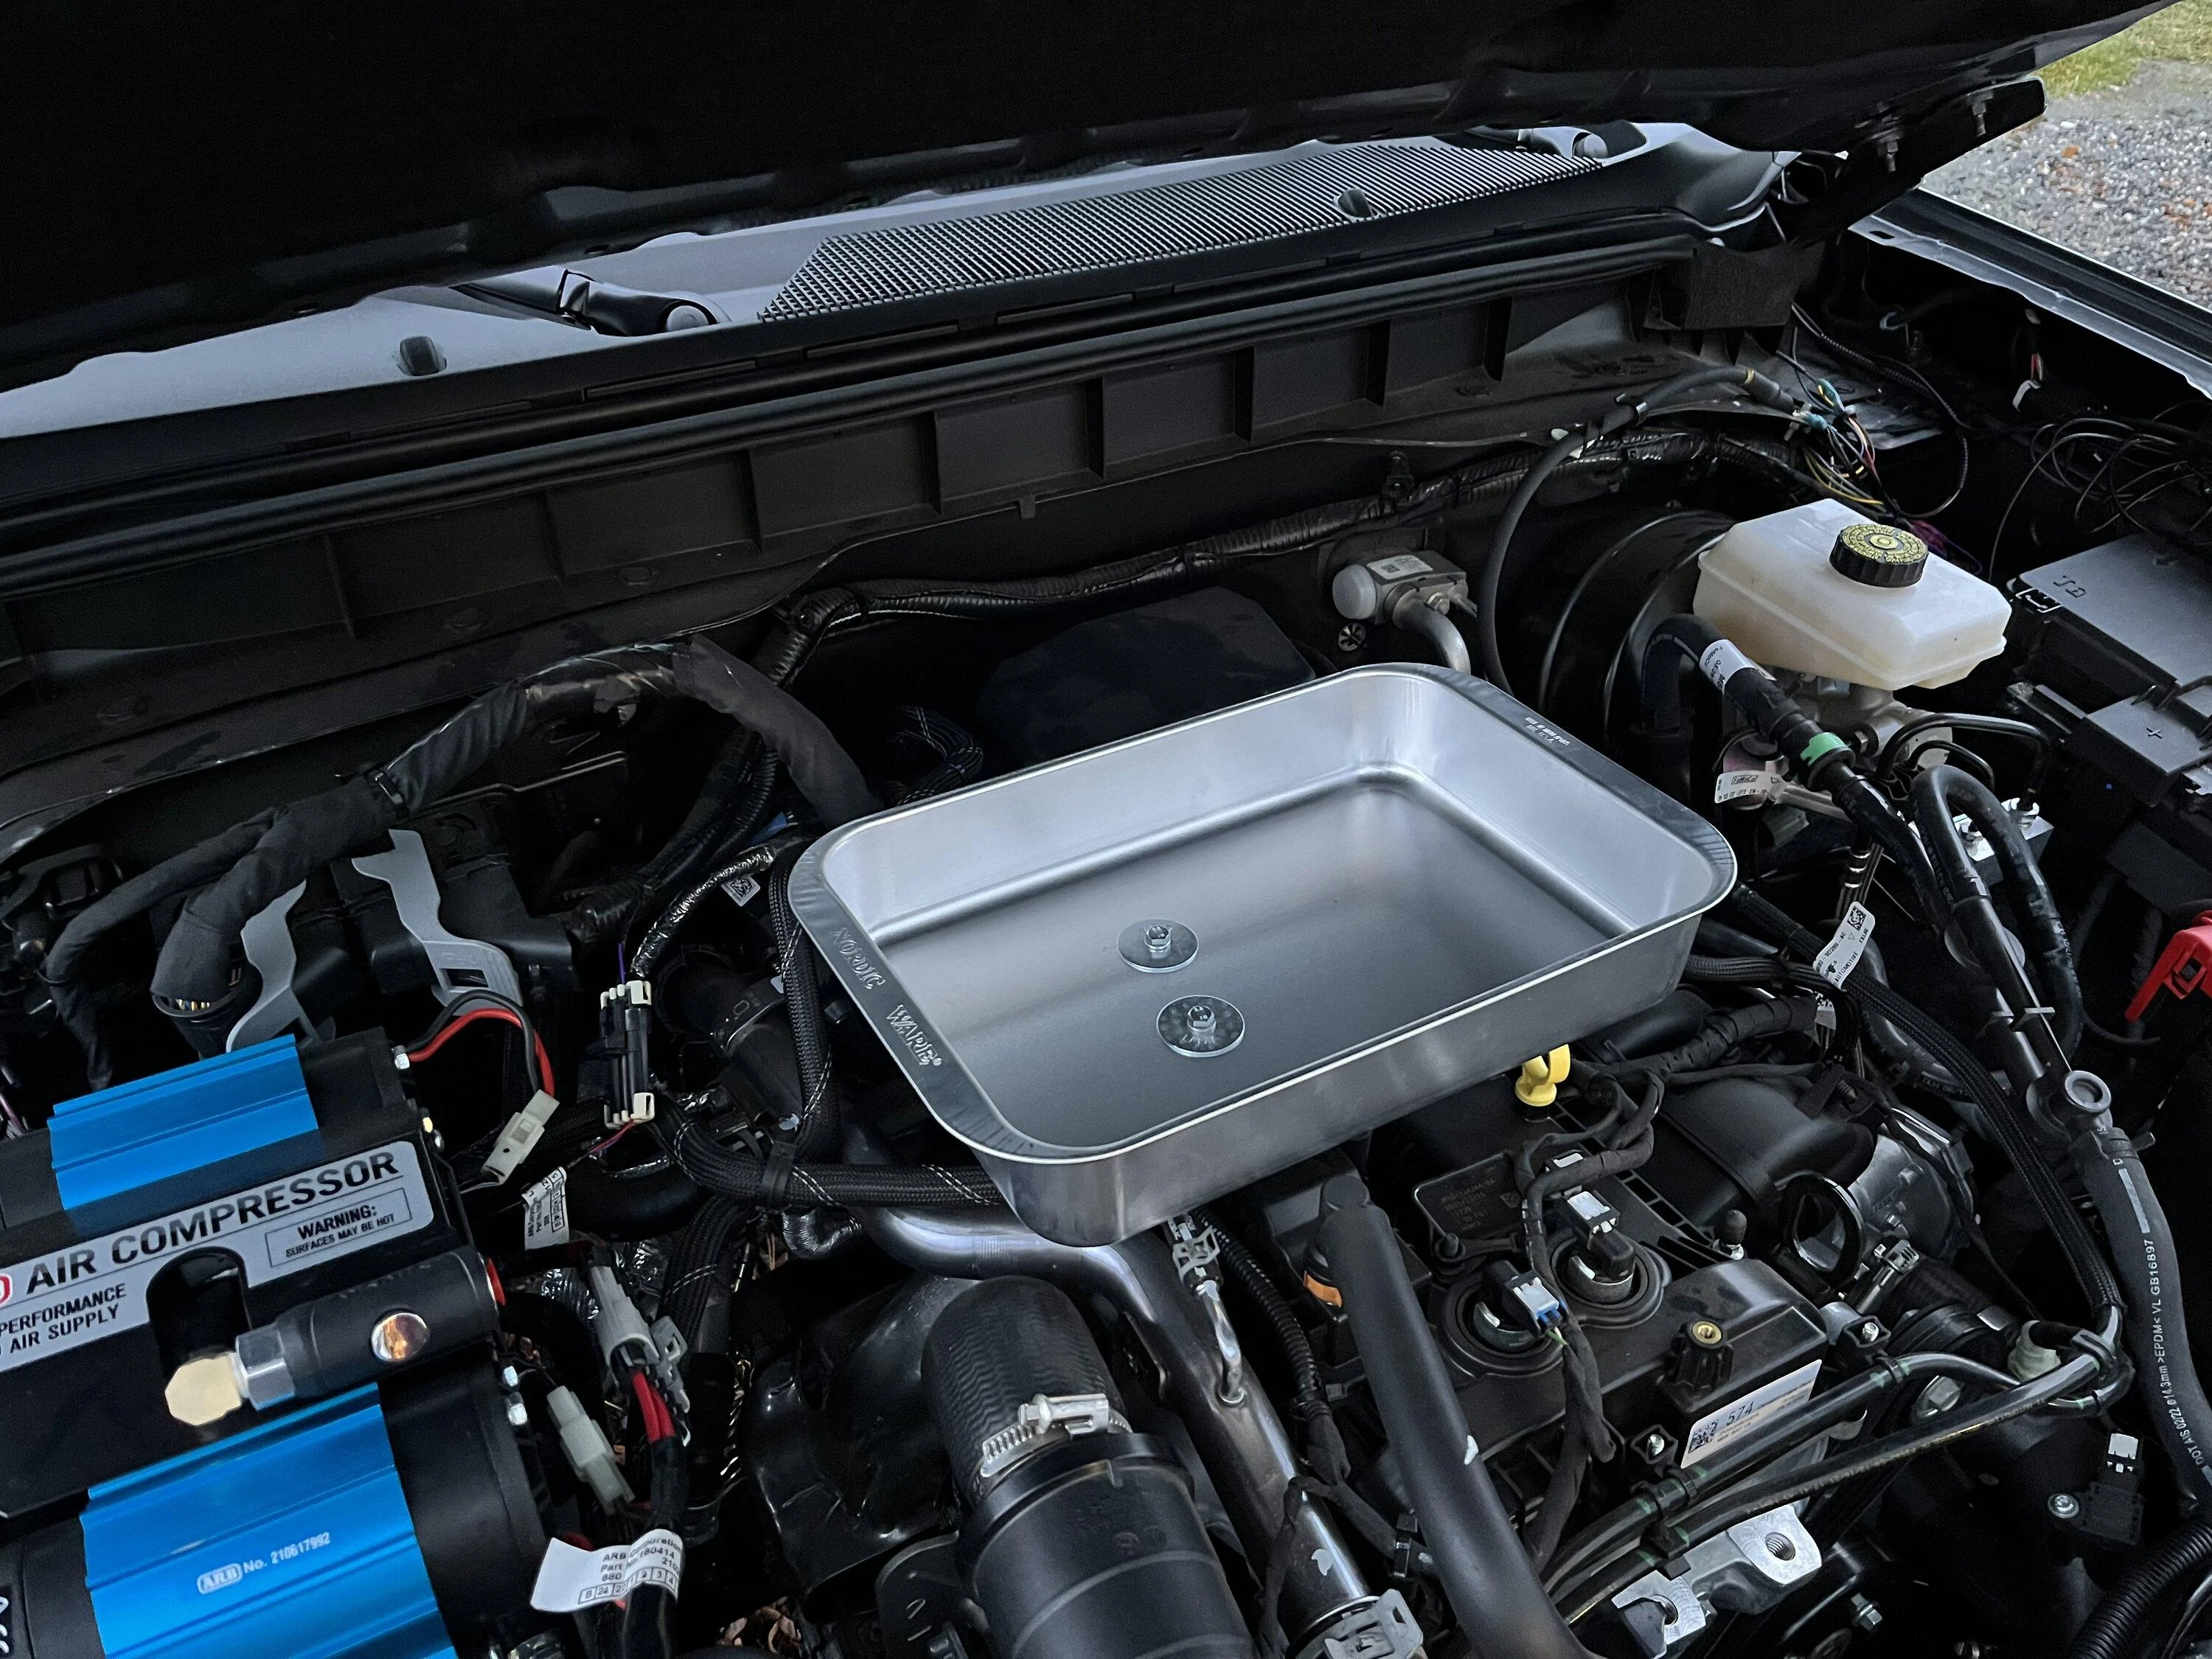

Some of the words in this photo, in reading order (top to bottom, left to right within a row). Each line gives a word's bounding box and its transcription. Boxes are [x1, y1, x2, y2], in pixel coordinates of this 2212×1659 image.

[830, 928, 886, 990] NORDIC
[1834, 951, 1858, 982] AUTOMOTIVE
[886, 1004, 938, 1065] WARE
[27, 1250, 97, 1295] AIR
[111, 1152, 399, 1264] COMPRESSOR
[285, 1234, 335, 1258] SURFACES
[338, 1225, 358, 1239] MAY
[361, 1221, 374, 1232] BE
[377, 1214, 394, 1227] HOT
[298, 1205, 378, 1240] WARNING:
[2144, 1239, 2160, 1295] GB16897
[0, 1282, 127, 1337] PERFORMANCE
[2152, 1299, 2162, 1315] VL
[10, 1331, 40, 1354] AIR
[48, 1303, 119, 1340] SUPPLY
[1725, 1400, 1754, 1427] 574
[243, 1559, 268, 1574] No.
[600, 1563, 623, 1573] Part
[602, 1552, 627, 1562] ARB
